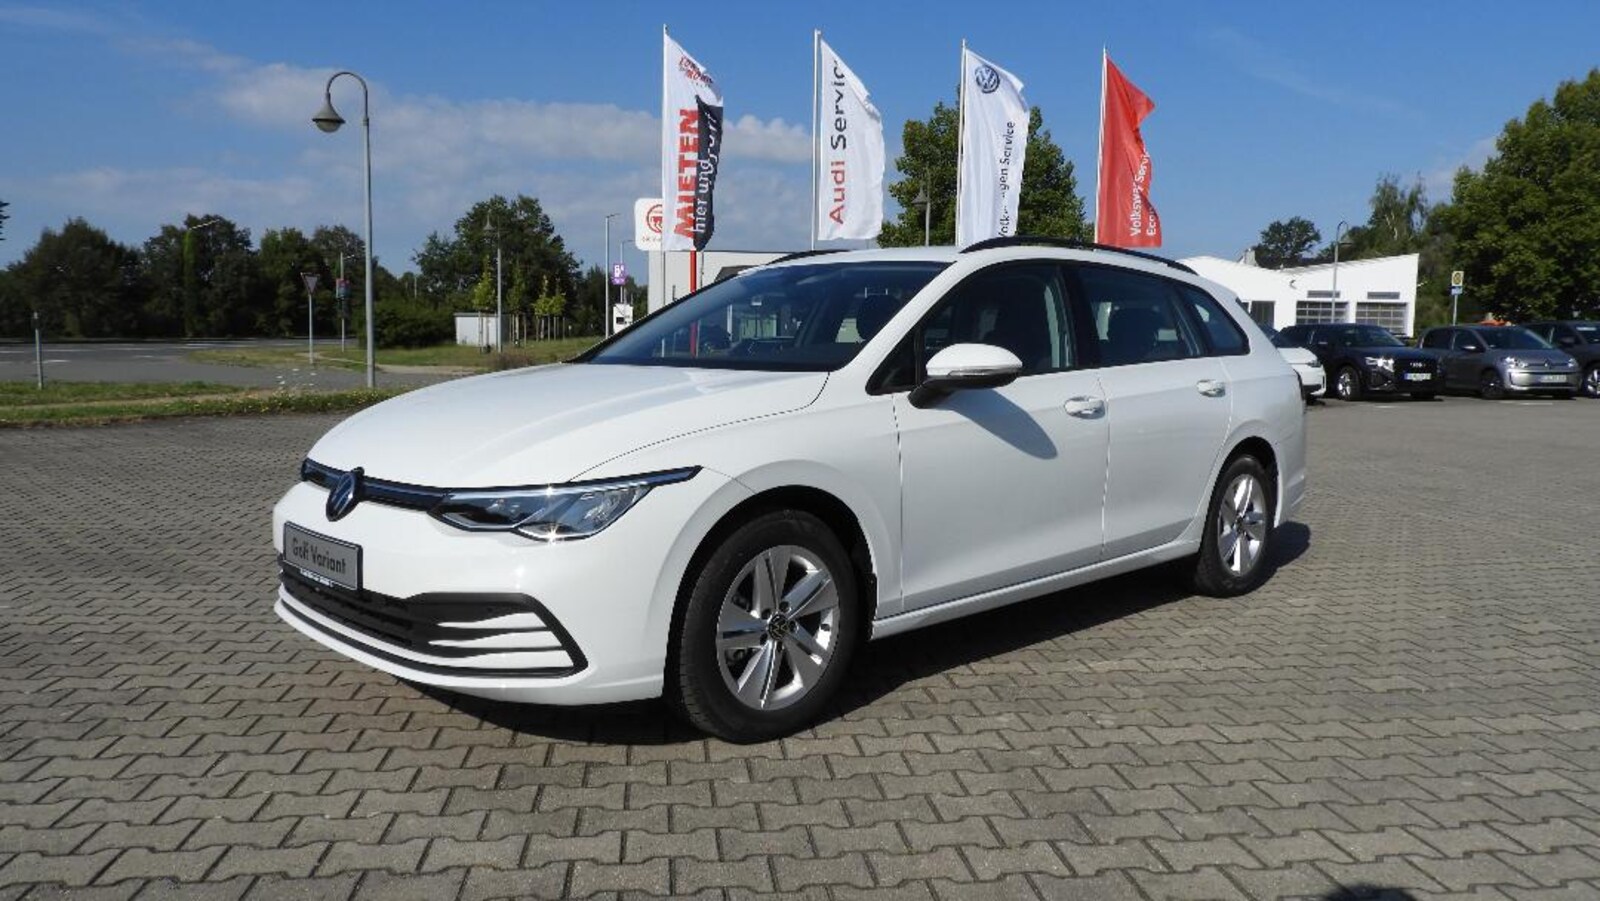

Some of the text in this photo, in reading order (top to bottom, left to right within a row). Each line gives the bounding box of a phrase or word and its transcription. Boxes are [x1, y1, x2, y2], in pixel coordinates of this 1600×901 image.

[829, 60, 847, 225] Audi Servic
[1000, 121, 1015, 166] Service
[674, 109, 699, 238] MIETEN
[692, 198, 708, 233] hier
[310, 545, 347, 575] Variant
